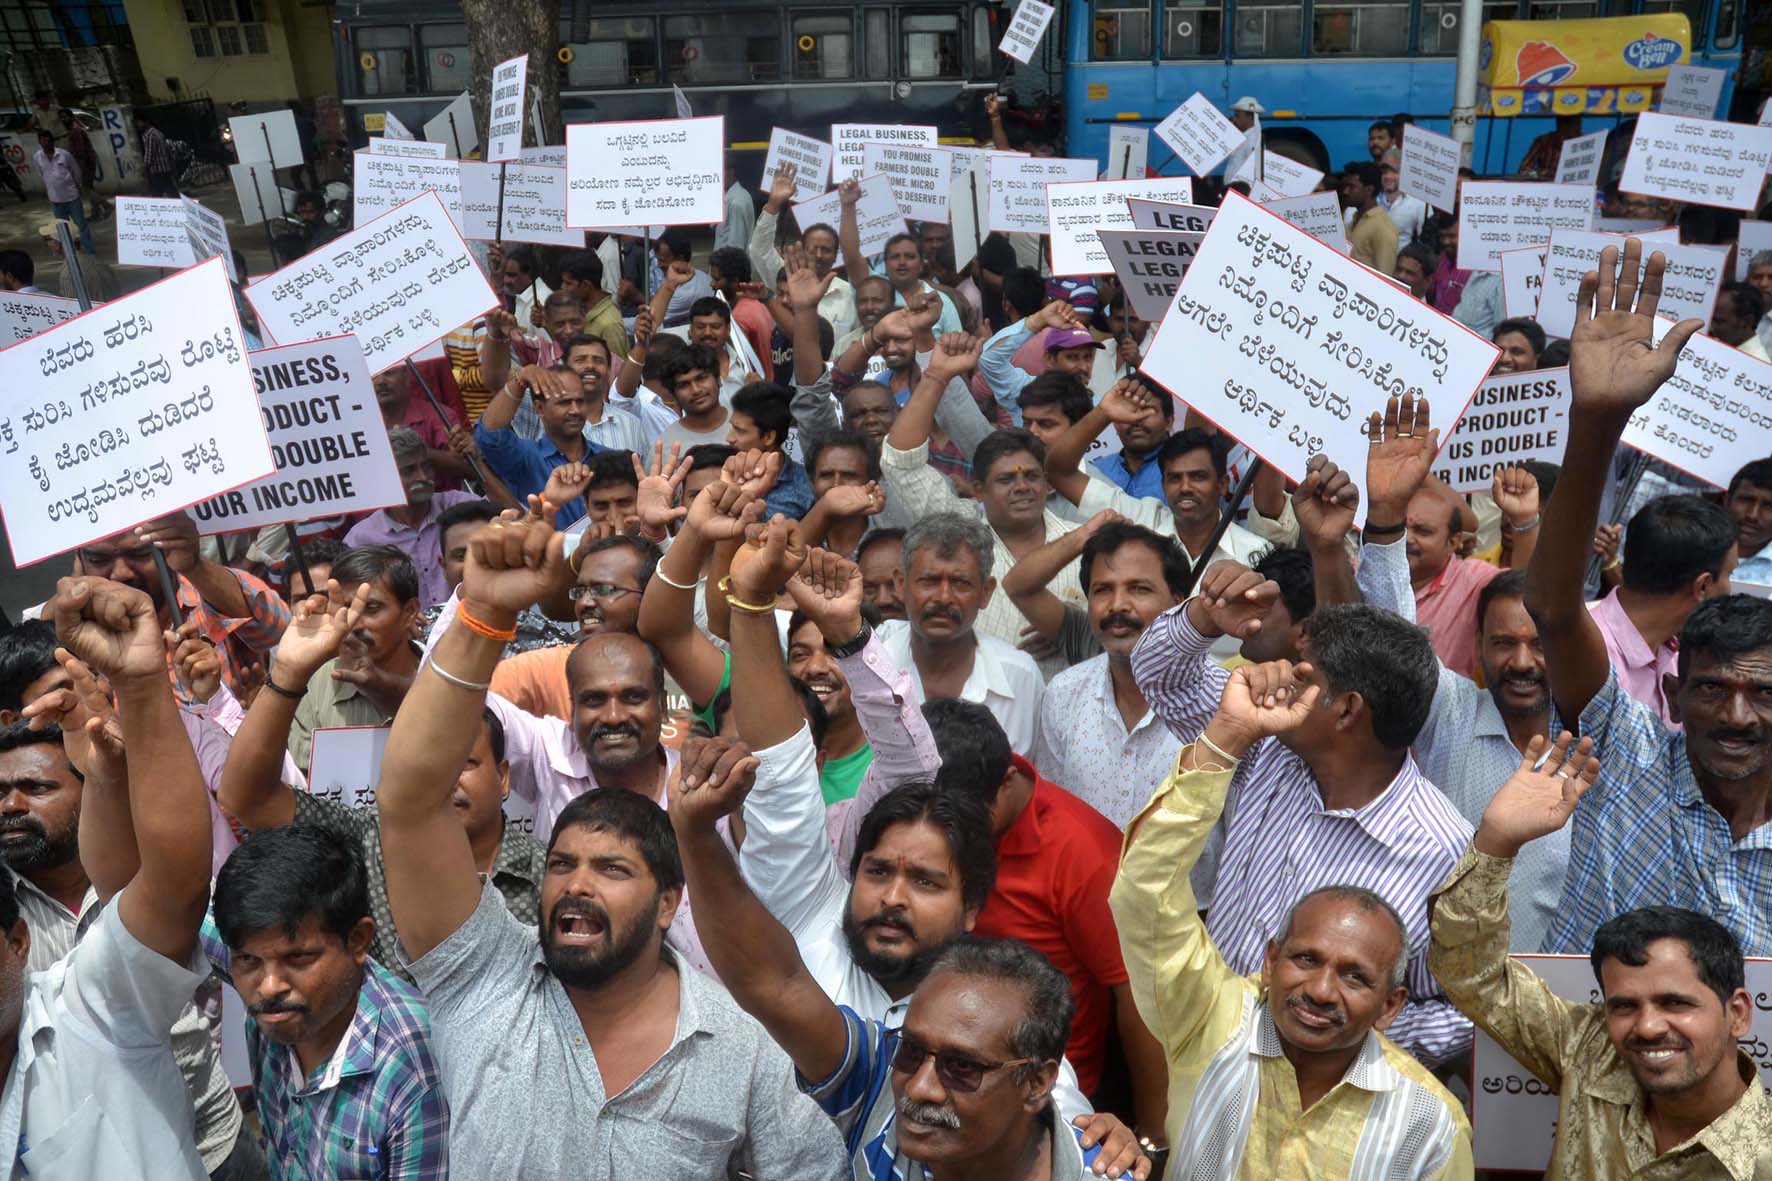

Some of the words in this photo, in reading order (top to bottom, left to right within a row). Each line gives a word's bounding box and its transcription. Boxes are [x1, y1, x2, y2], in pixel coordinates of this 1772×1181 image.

[1628, 41, 1675, 58] Cream
[1638, 51, 1667, 70] Bell
[606, 132, 649, 151] ಒಗ್ಗಟ್ಟಿನಲ್ಲಿ
[653, 131, 687, 144] ಬಲವಿದೆ
[840, 129, 873, 139] LEGAL
[875, 130, 930, 142] BUSINESS,
[621, 154, 671, 170] ಎಂಬುದನ್ನು
[875, 161, 909, 175] FARMERS
[910, 164, 939, 177] DOUBLE
[883, 149, 898, 160] YOU
[899, 150, 932, 163] PROMISE
[570, 177, 620, 190] ಅರಿಯೋಣ
[905, 190, 937, 205] DESERVE
[938, 195, 947, 206] IT
[910, 178, 935, 191] MICRO
[595, 199, 616, 210] ಸದಾ
[634, 195, 696, 209] ಜೋಡಿಸೋಣ
[1153, 211, 1213, 232] LEG
[271, 264, 335, 301] ಚಿಕ್ಕಪುಟ್ಟ
[332, 213, 433, 268] ವ್ಯಾಪಾರಿಗಳನ್ನು
[289, 276, 364, 327] ನಿಮ್ಮೊಂದಿಗೆ
[367, 238, 445, 285] ಸೇರಿಸಿಕೊಳ್ಳಿ
[339, 280, 423, 334] ಬೆಳೆಯುವುದು
[427, 254, 471, 286] ದೇಶದ
[1219, 265, 1319, 340] ನಿಮ್ಮೊಂದಿಗೆ
[1236, 224, 1313, 293] ಚಿಕ್ಕಪುಟ್ಟ
[1318, 273, 1449, 385] ವ್ಯಾಪಾರಿಗಳನ್ನು
[408, 308, 441, 330] ಬಳ್ಳಿ
[40, 336, 95, 377] ಬೆವರು
[103, 313, 153, 349] ಹರಸಿ
[1178, 295, 1233, 341] ಆಗಲೇ
[1239, 335, 1352, 421] ಬೆಳೆಯುವುದು
[0, 416, 19, 455] ಕ್ತ
[22, 401, 73, 435] ಸುರಿಸಿ
[80, 353, 172, 411] ಗಳಿಸುವೆವು
[181, 327, 241, 368] ರೊಟ್ಟಿ
[1224, 379, 1286, 429] ಆರ್ಥಿಕ
[1455, 406, 1549, 435] PRODUCT
[1658, 397, 1738, 443] ನೀಡಲಾರರು
[28, 454, 51, 492] ಕೈ
[55, 427, 130, 471] ಜೋಡಿಸಿ
[138, 385, 214, 437] ದುಡಿದರೆ
[271, 431, 371, 470] DOUBLE
[1449, 441, 1474, 460] US
[1481, 430, 1558, 456] DOUBLE
[1653, 424, 1714, 459] ತೊಂದರೆ
[47, 456, 173, 524] ಉದ್ಯಮವೆಲ್ಲವು
[193, 490, 248, 521] OUR
[252, 472, 356, 511] INCOME
